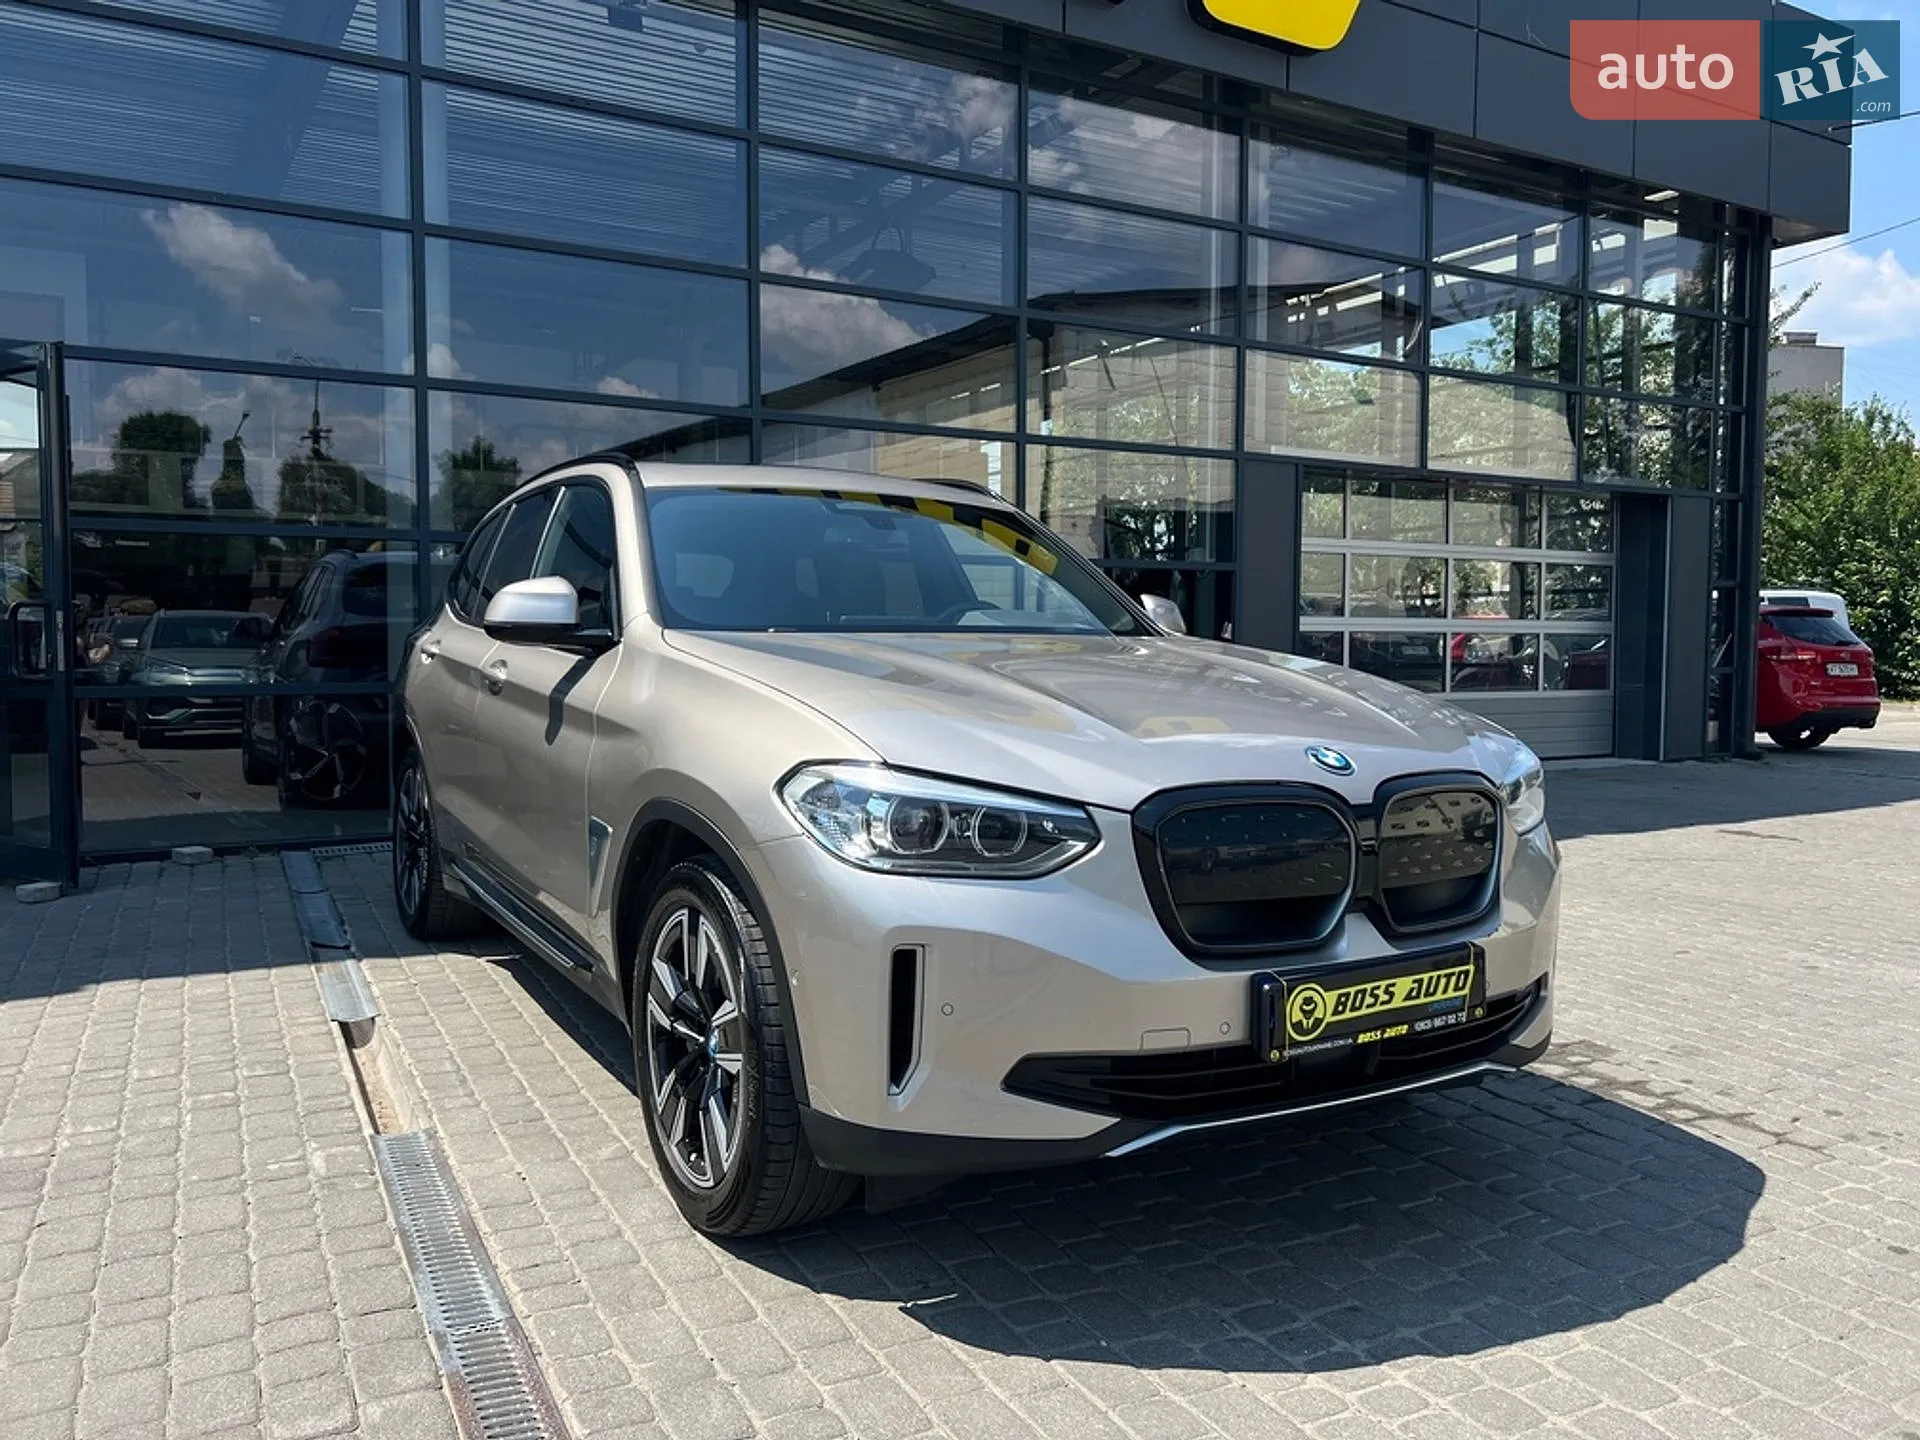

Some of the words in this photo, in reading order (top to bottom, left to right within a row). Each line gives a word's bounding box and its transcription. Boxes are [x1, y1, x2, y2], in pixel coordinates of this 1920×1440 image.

[1331, 982, 1398, 1016] BOSS
[1402, 969, 1470, 1002] AUTO
[1356, 1030, 1382, 1044] BOSS
[1383, 1024, 1409, 1039] AUTO
